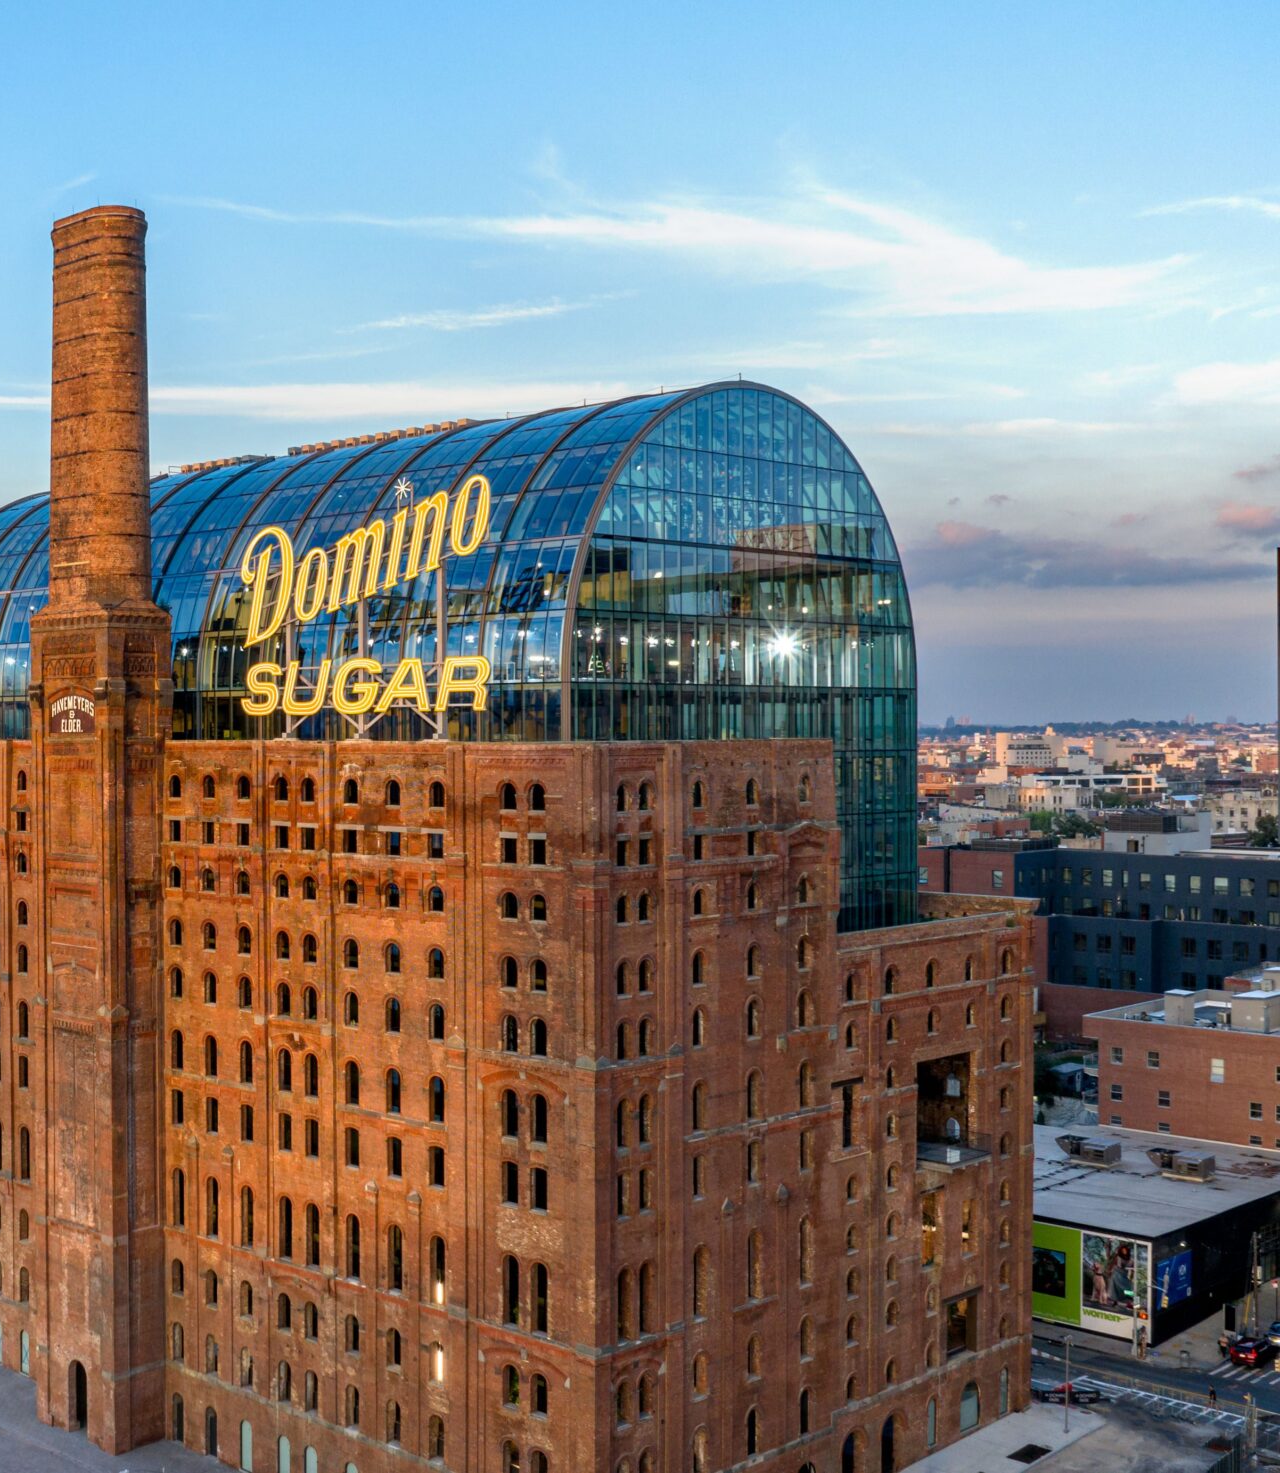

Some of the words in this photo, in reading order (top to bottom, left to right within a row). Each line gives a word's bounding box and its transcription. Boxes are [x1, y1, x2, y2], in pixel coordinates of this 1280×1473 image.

[241, 474, 491, 649] Domino
[51, 695, 95, 718] HAVEMEYERS
[241, 656, 491, 716] SUGAR
[69, 710, 75, 719] &
